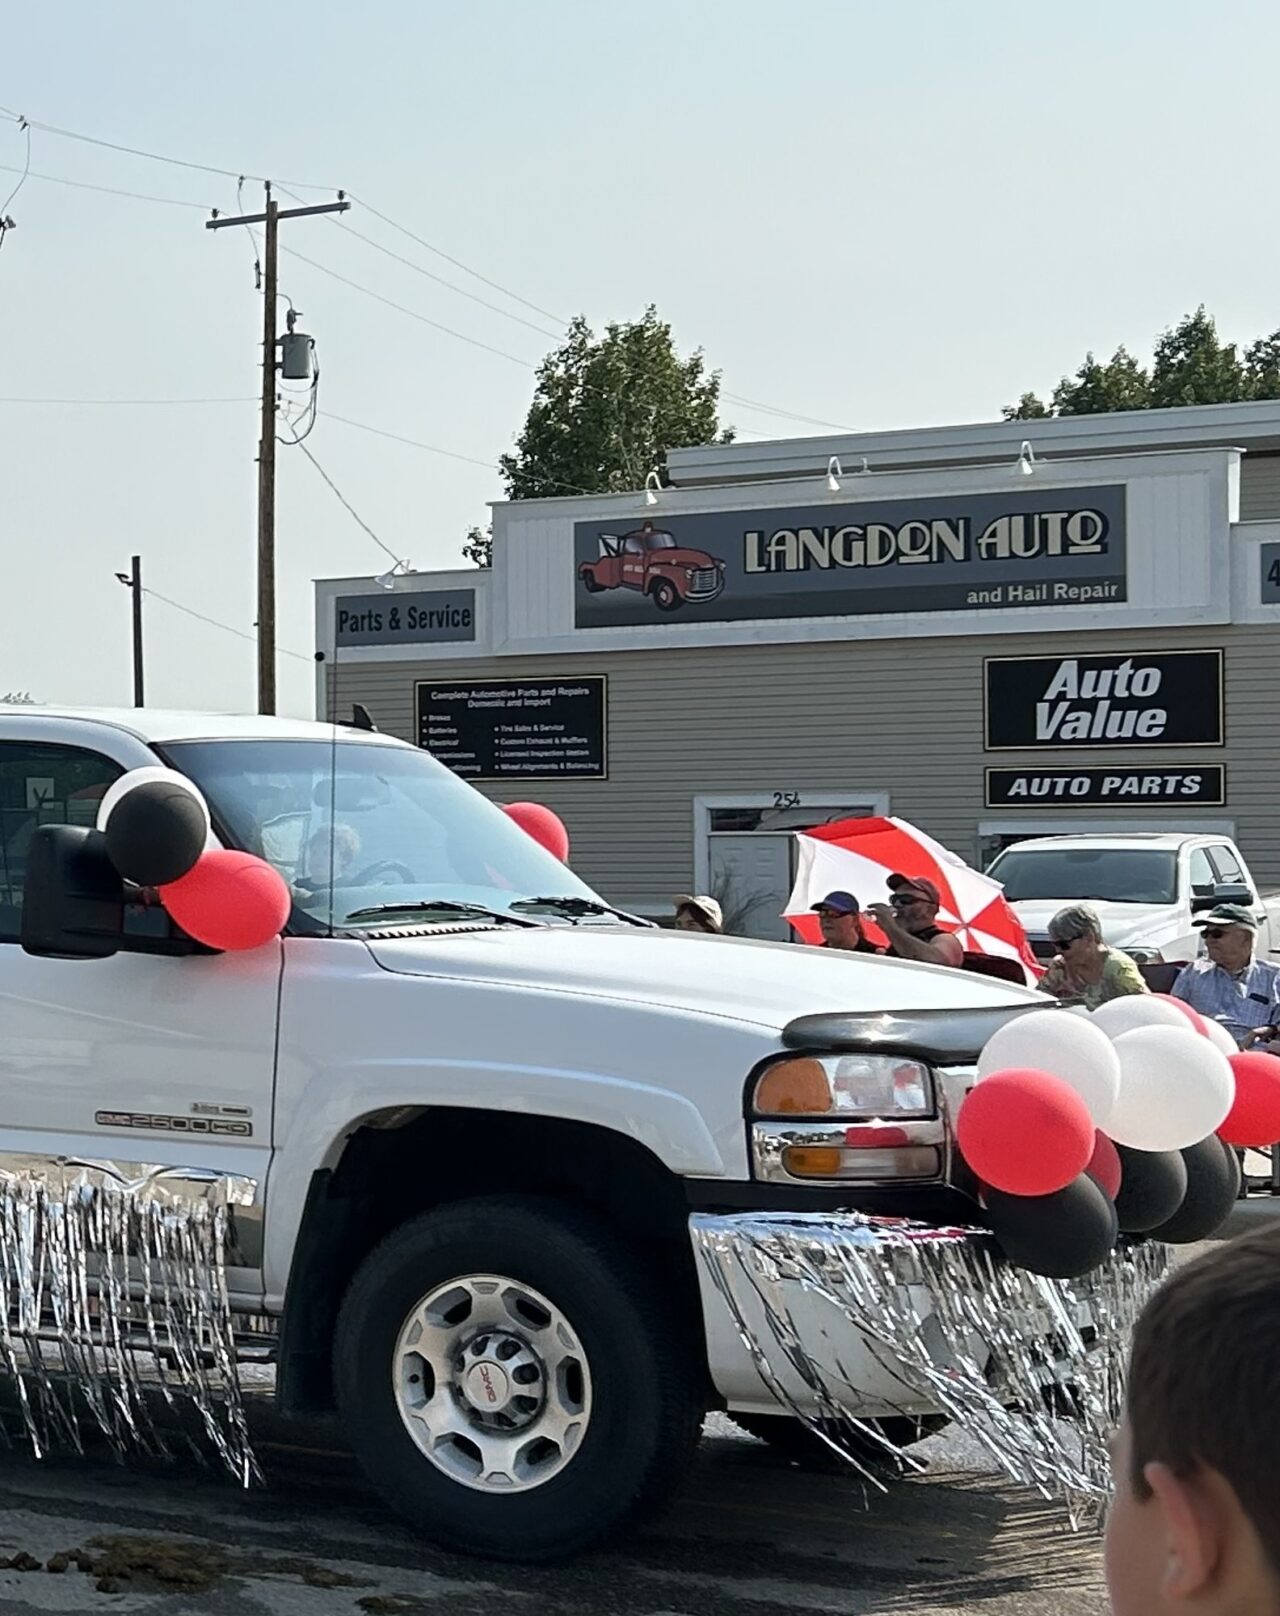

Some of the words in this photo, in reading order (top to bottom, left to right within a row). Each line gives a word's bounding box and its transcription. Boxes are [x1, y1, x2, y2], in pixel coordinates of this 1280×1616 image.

[745, 518, 966, 574] LANGDON
[977, 509, 1106, 560] AUTO
[966, 587, 1002, 604] and
[1007, 584, 1047, 602] Hail
[1054, 581, 1119, 602] Repair
[338, 609, 383, 633] Parts
[388, 607, 401, 631] &
[407, 604, 471, 630] Service
[1042, 658, 1162, 700] Auto
[431, 690, 470, 700] Complete
[470, 689, 516, 699] Automotive
[517, 688, 539, 697] Parts
[540, 687, 556, 696] and
[557, 686, 590, 697] Repairs
[467, 699, 506, 708] Domestic
[506, 699, 523, 707] and
[523, 698, 551, 707] Import
[1036, 700, 1168, 741] Value
[1007, 777, 1092, 796] AUTO
[1100, 775, 1203, 795] PARTS
[773, 791, 801, 809] 254
[479, 1365, 497, 1403] GMC
